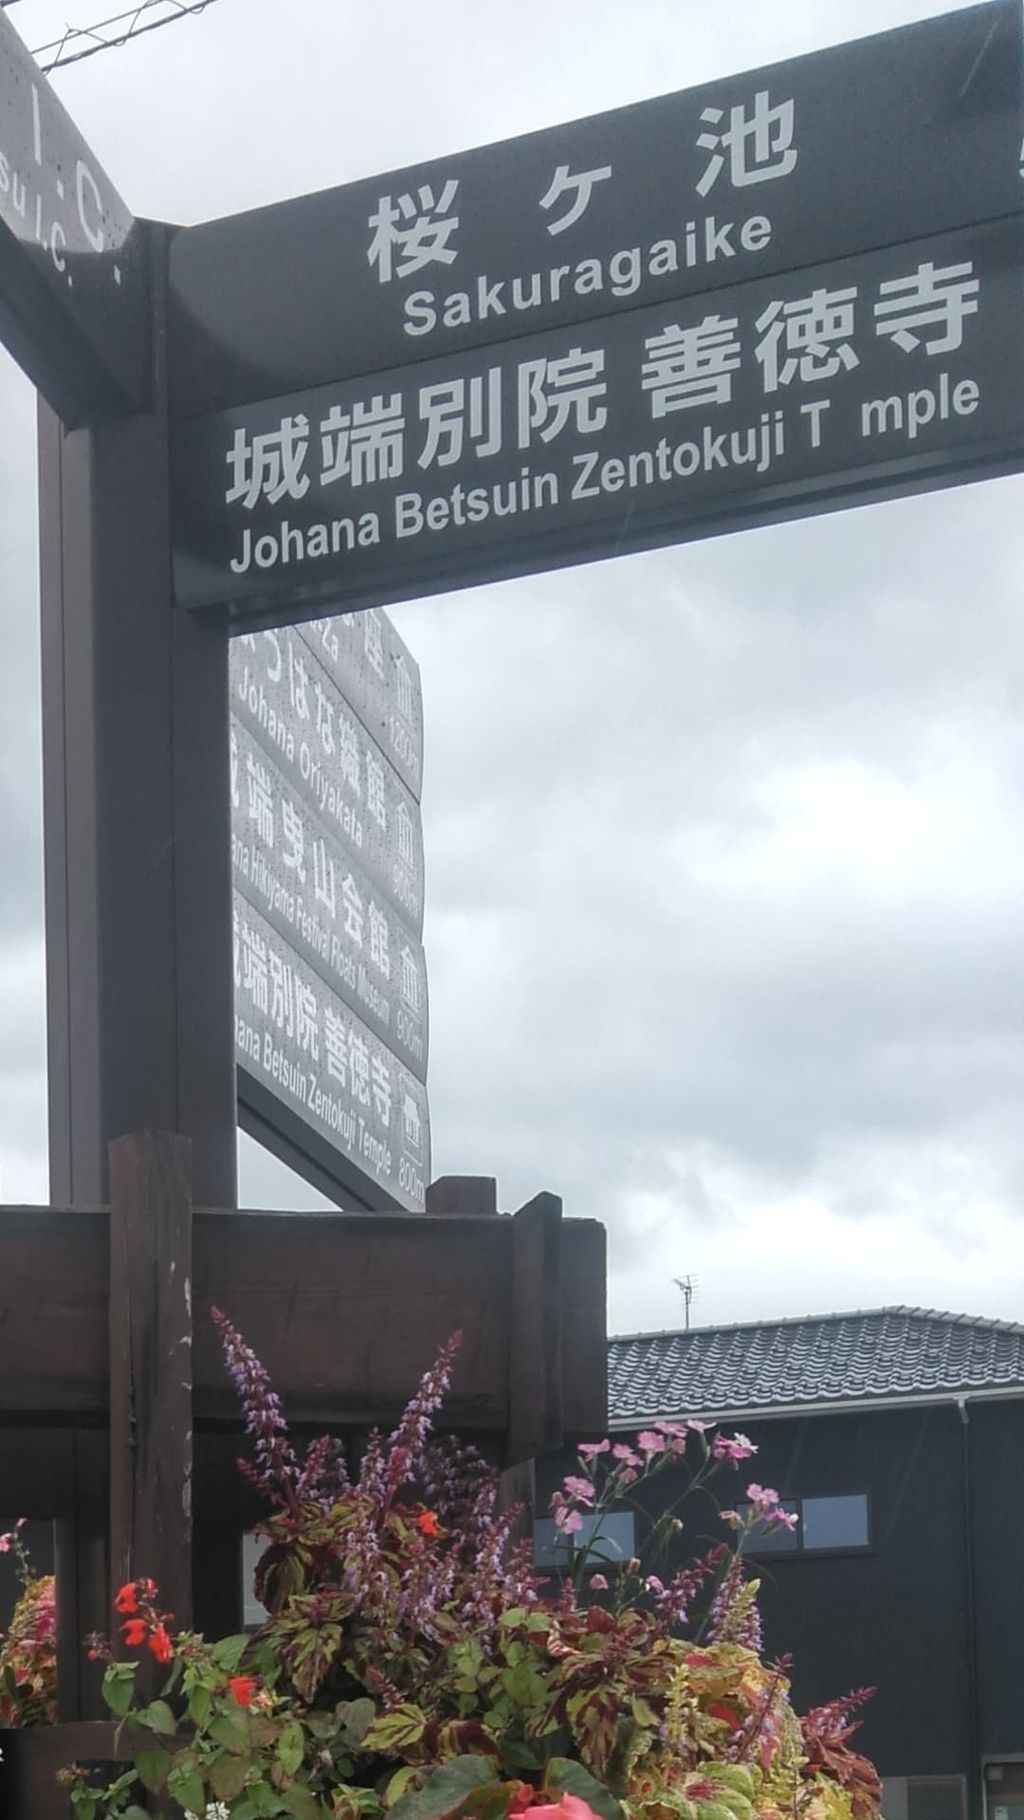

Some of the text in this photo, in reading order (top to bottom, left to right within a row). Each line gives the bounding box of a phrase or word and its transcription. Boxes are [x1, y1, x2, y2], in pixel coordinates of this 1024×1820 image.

[402, 214, 773, 338] Sakuragaike
[229, 513, 380, 575] Johana
[396, 469, 559, 539] Betsuin
[571, 410, 785, 501] Zentokuji
[238, 665, 363, 849] Johana Oriyakata
[230, 732, 391, 980] 端曳山会館
[233, 911, 320, 1062] 端別院
[263, 1032, 307, 1103] Betsuin
[307, 1074, 356, 1152] Zentokuji
[357, 1115, 392, 1176] Temple
